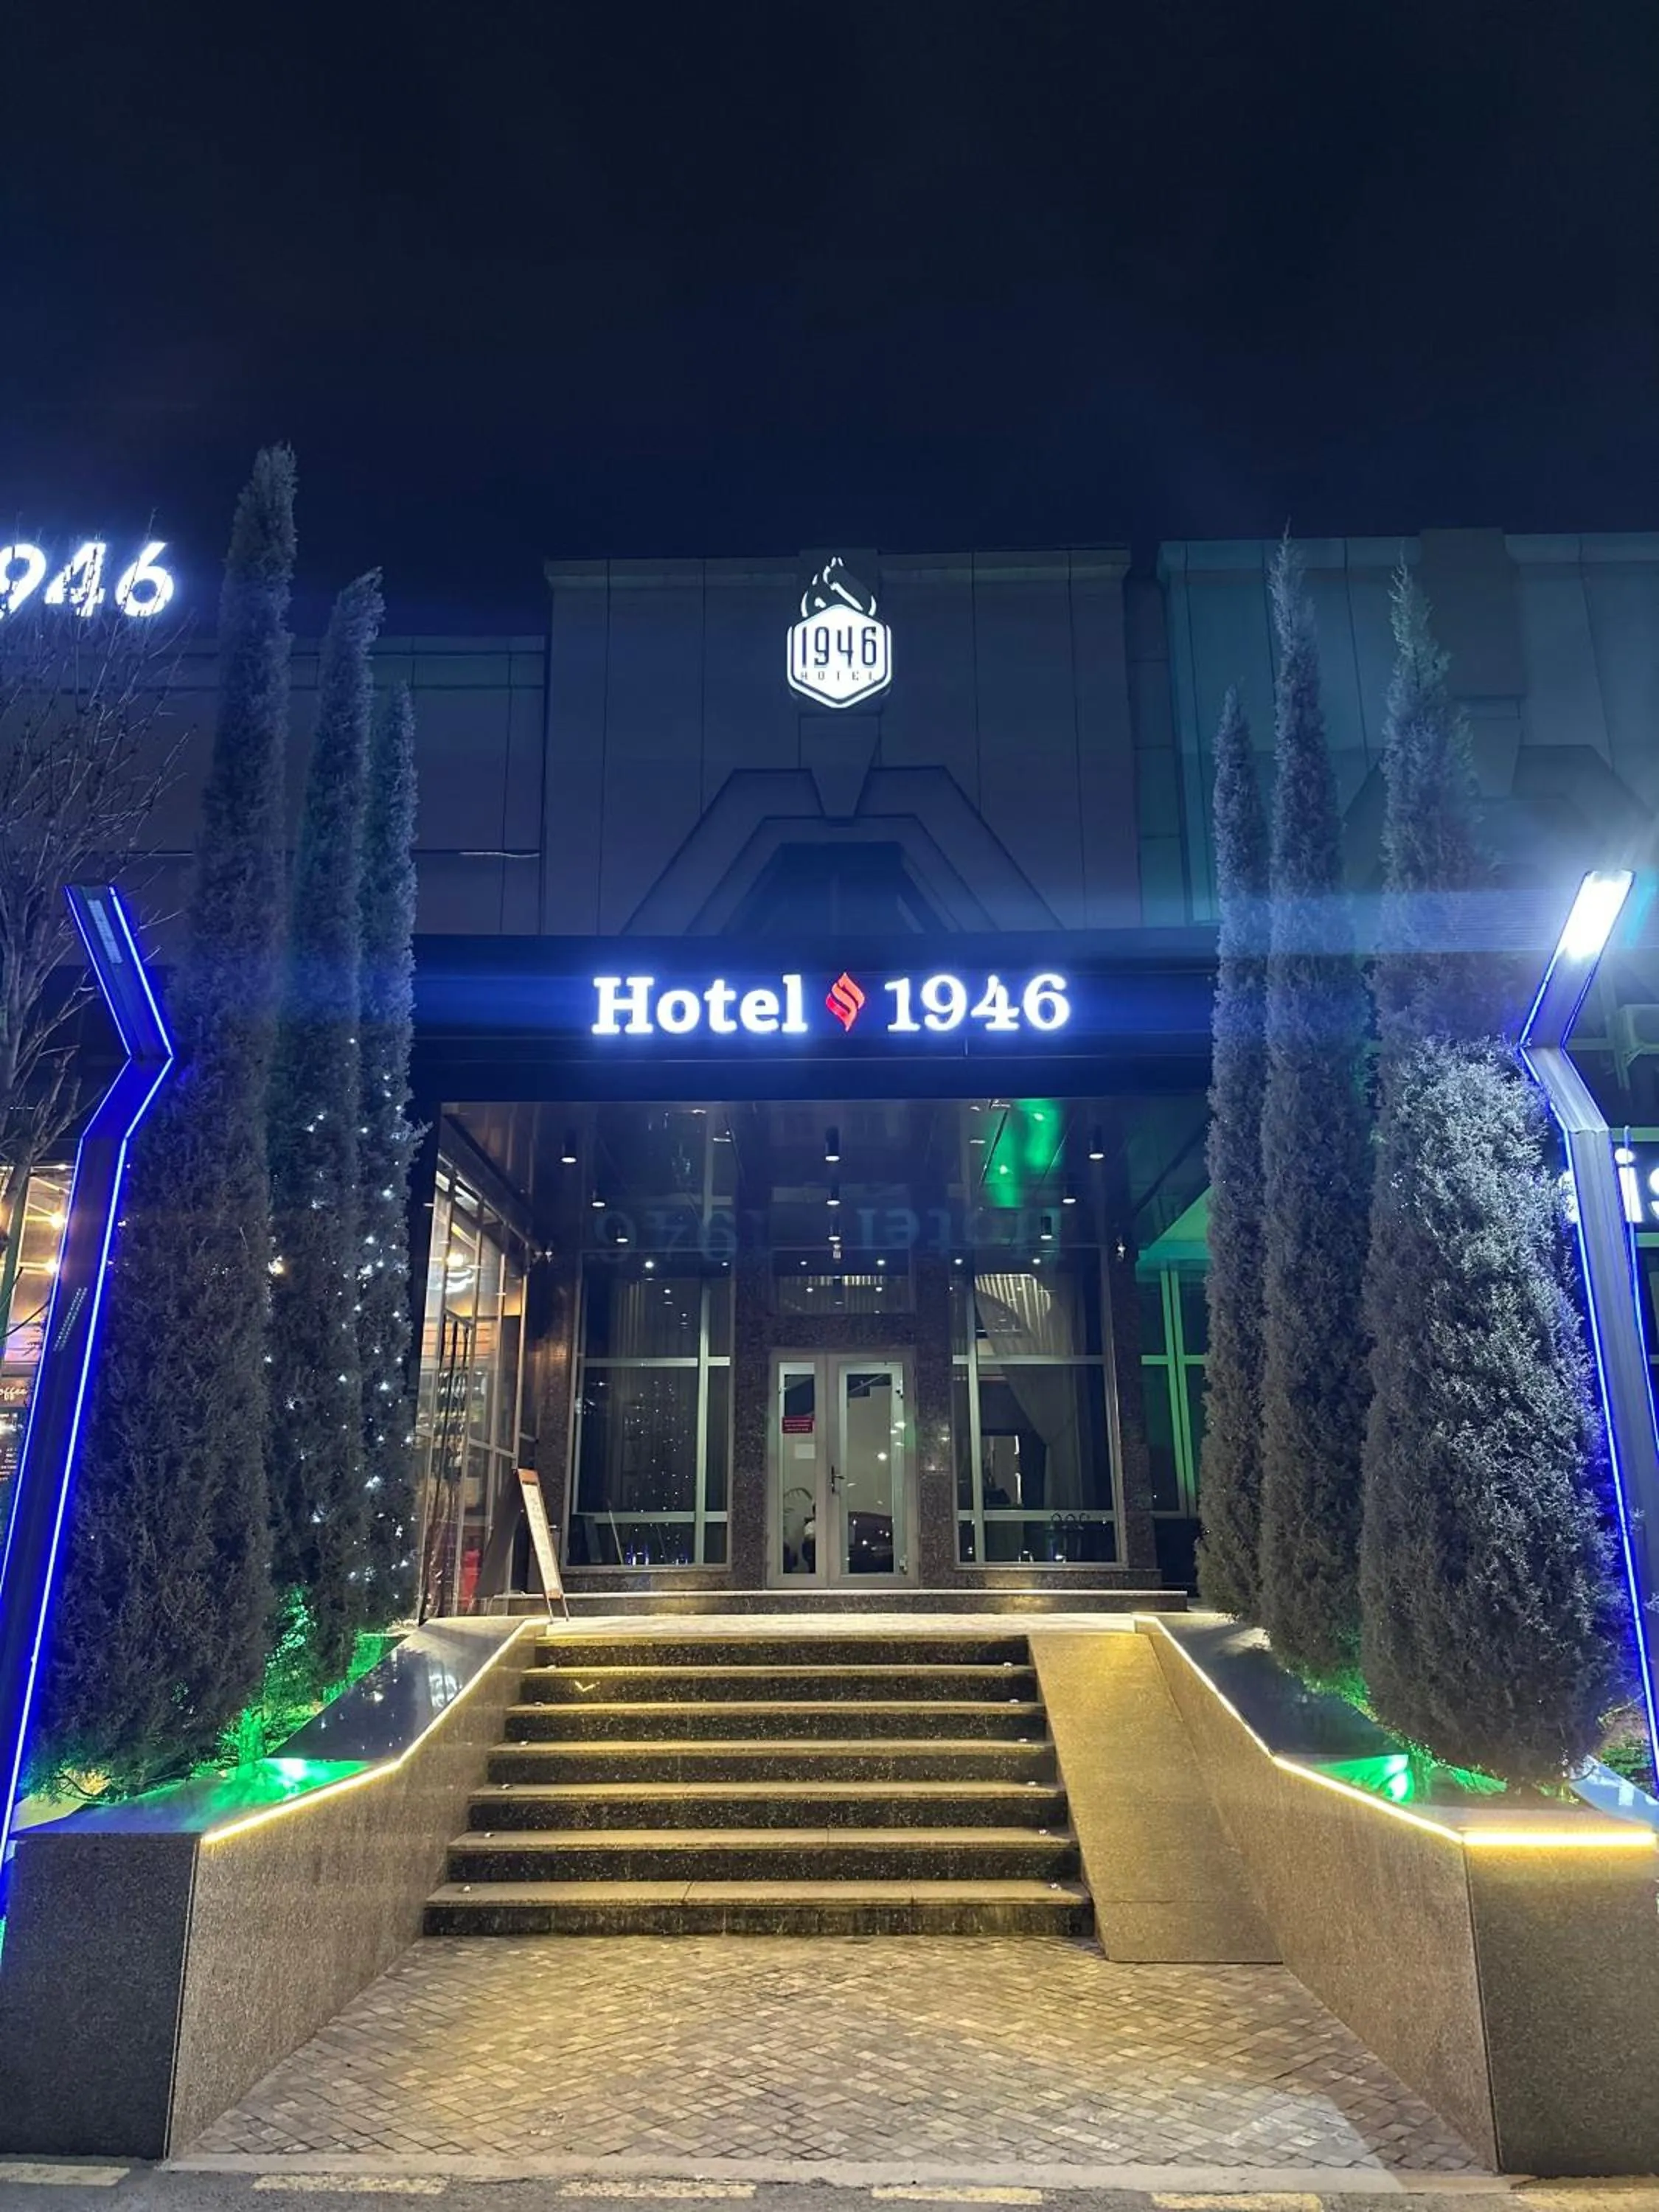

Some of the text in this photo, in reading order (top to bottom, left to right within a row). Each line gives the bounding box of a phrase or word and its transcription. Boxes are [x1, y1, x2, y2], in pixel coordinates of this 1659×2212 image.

[0, 543, 174, 619] 946
[802, 626, 877, 667] 1946
[592, 973, 1070, 1034] Hotel 1946
